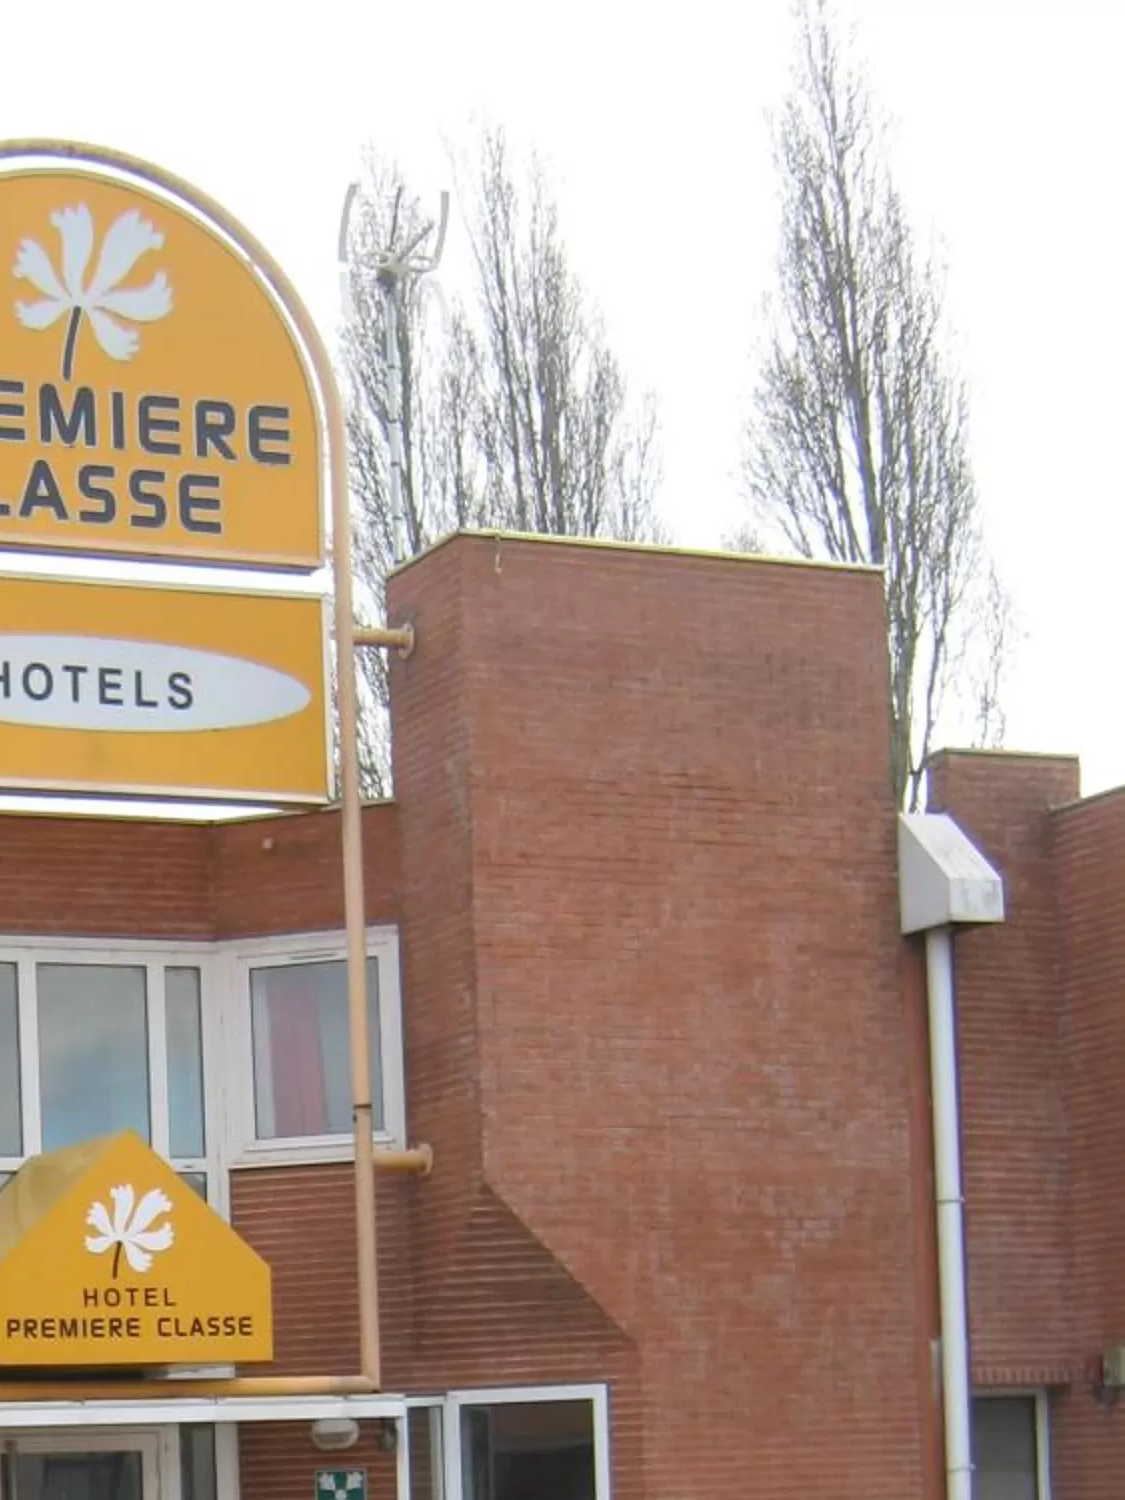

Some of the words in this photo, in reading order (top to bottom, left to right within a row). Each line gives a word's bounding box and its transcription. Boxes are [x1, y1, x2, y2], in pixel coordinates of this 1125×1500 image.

[83, 1287, 177, 1308] HOTEL
[6, 1317, 141, 1339] PREMIERE
[157, 1316, 254, 1338] CLASSE
